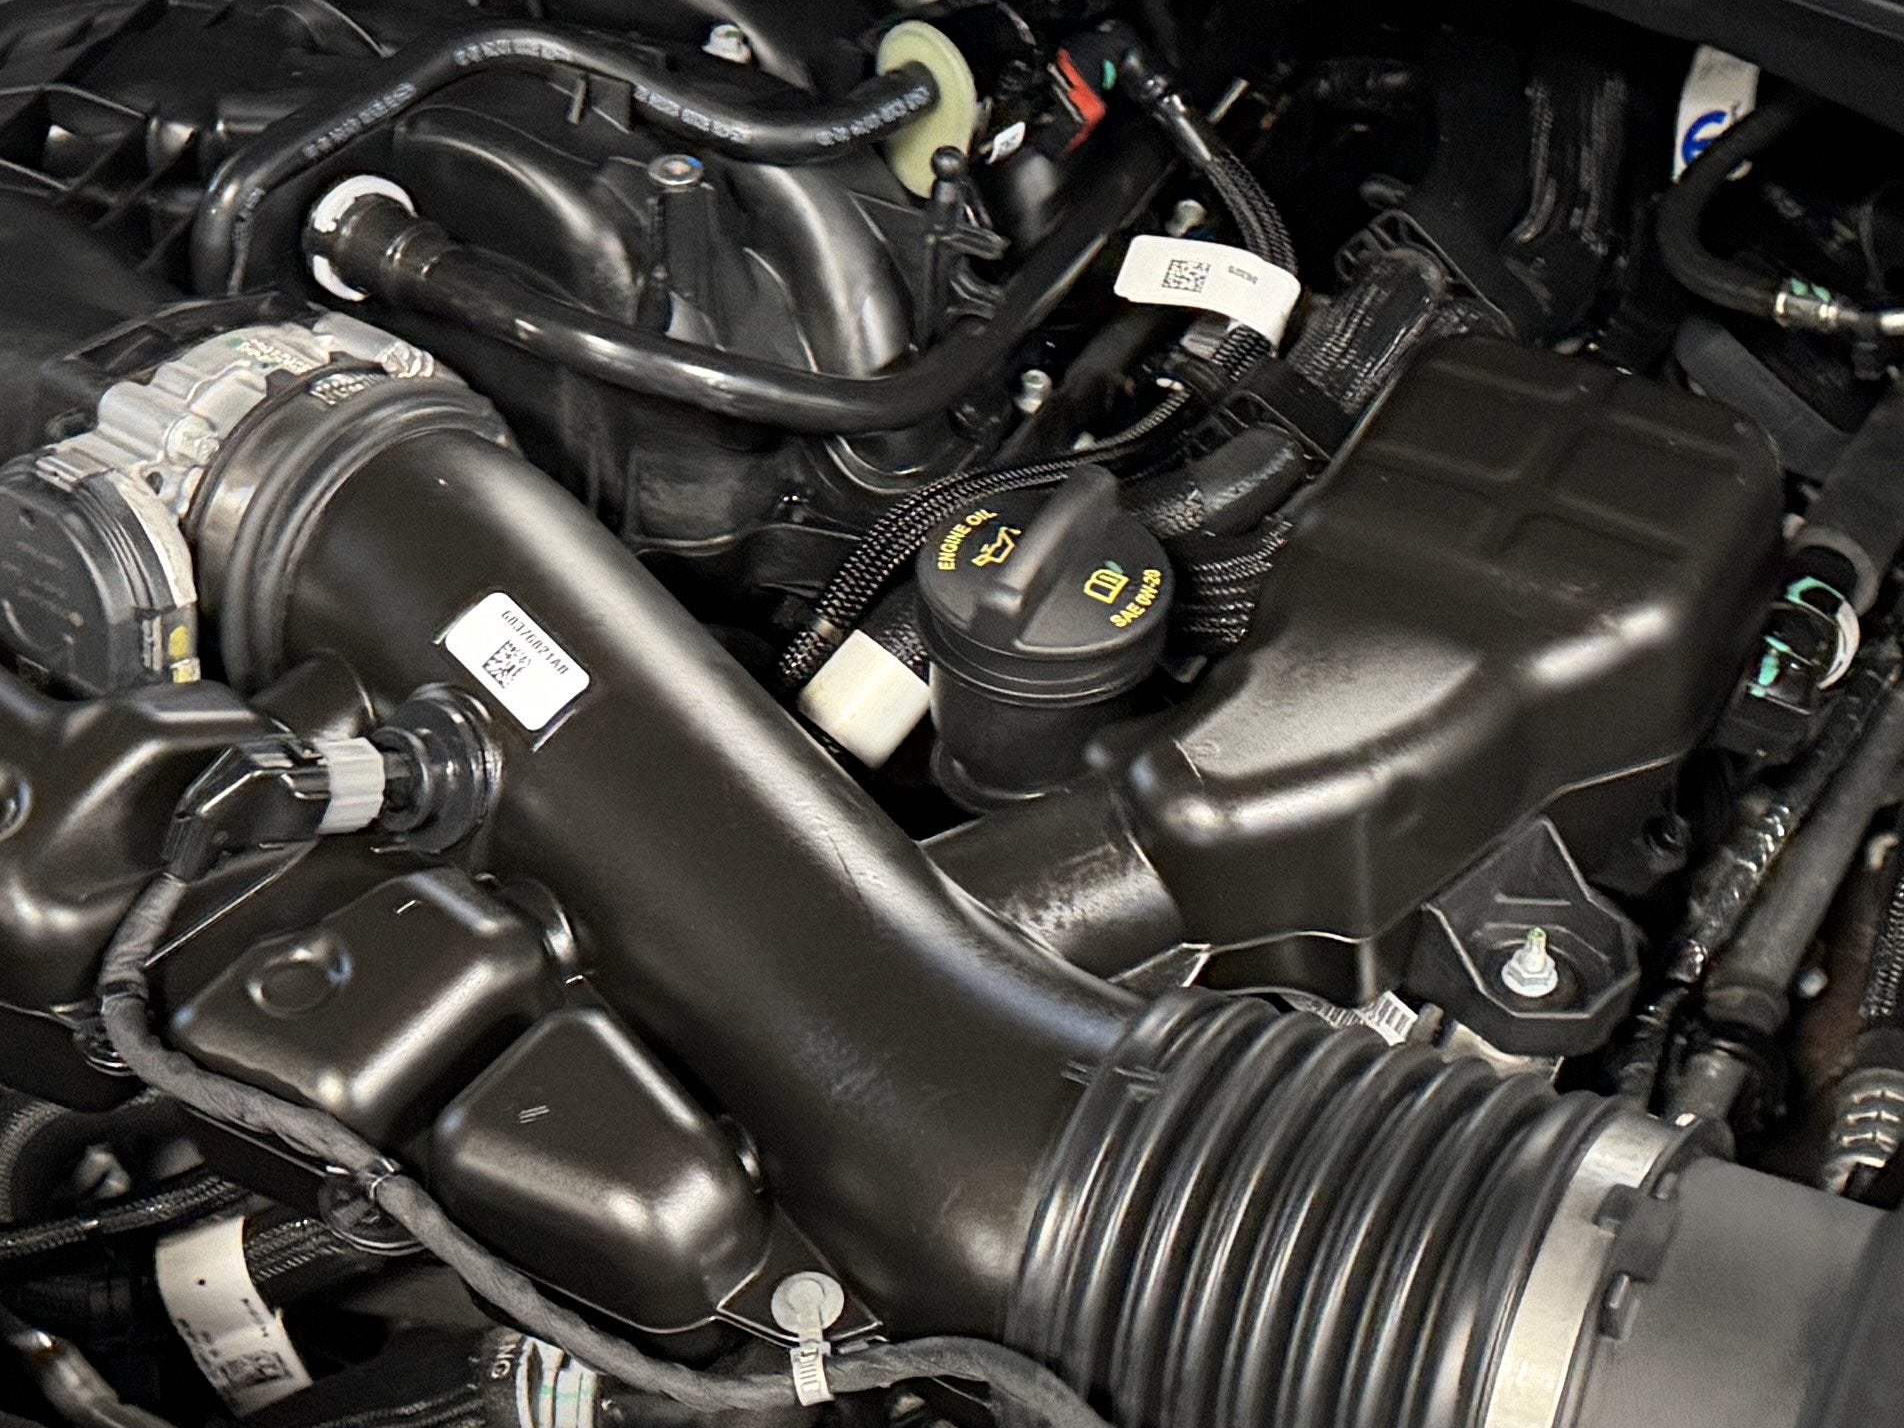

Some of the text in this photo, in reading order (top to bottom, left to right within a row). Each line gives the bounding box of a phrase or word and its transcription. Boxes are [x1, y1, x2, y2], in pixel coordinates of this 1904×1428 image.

[938, 508, 998, 570] ENGINE OIL
[1110, 569, 1162, 628] SAE 0W-20
